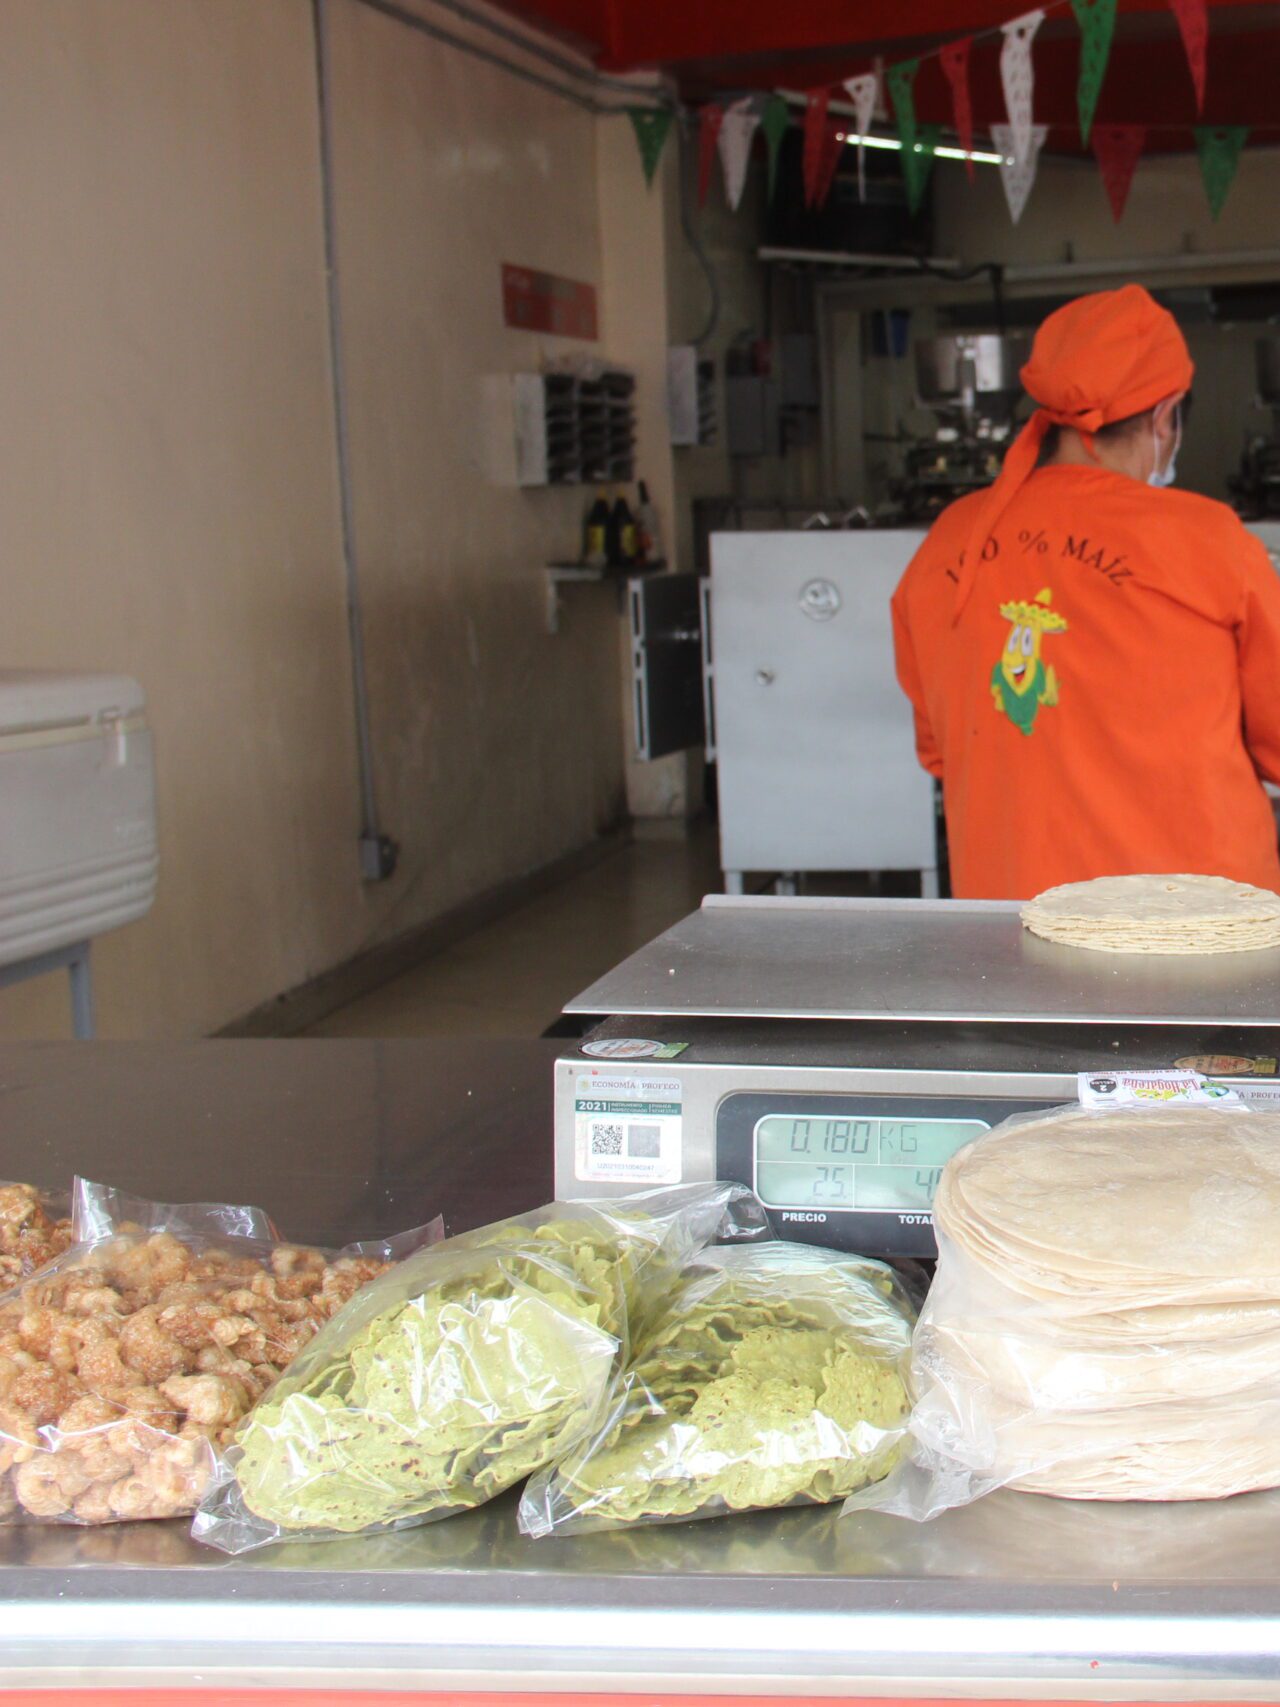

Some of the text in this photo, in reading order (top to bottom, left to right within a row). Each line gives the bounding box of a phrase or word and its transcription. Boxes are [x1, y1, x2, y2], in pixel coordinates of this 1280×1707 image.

[945, 530, 1134, 586] 10 % MAÍZ
[641, 1081, 680, 1091] PROFECO
[578, 1101, 607, 1111] 2021
[791, 1119, 871, 1153] 0.180
[782, 1211, 827, 1224] PRECIO
